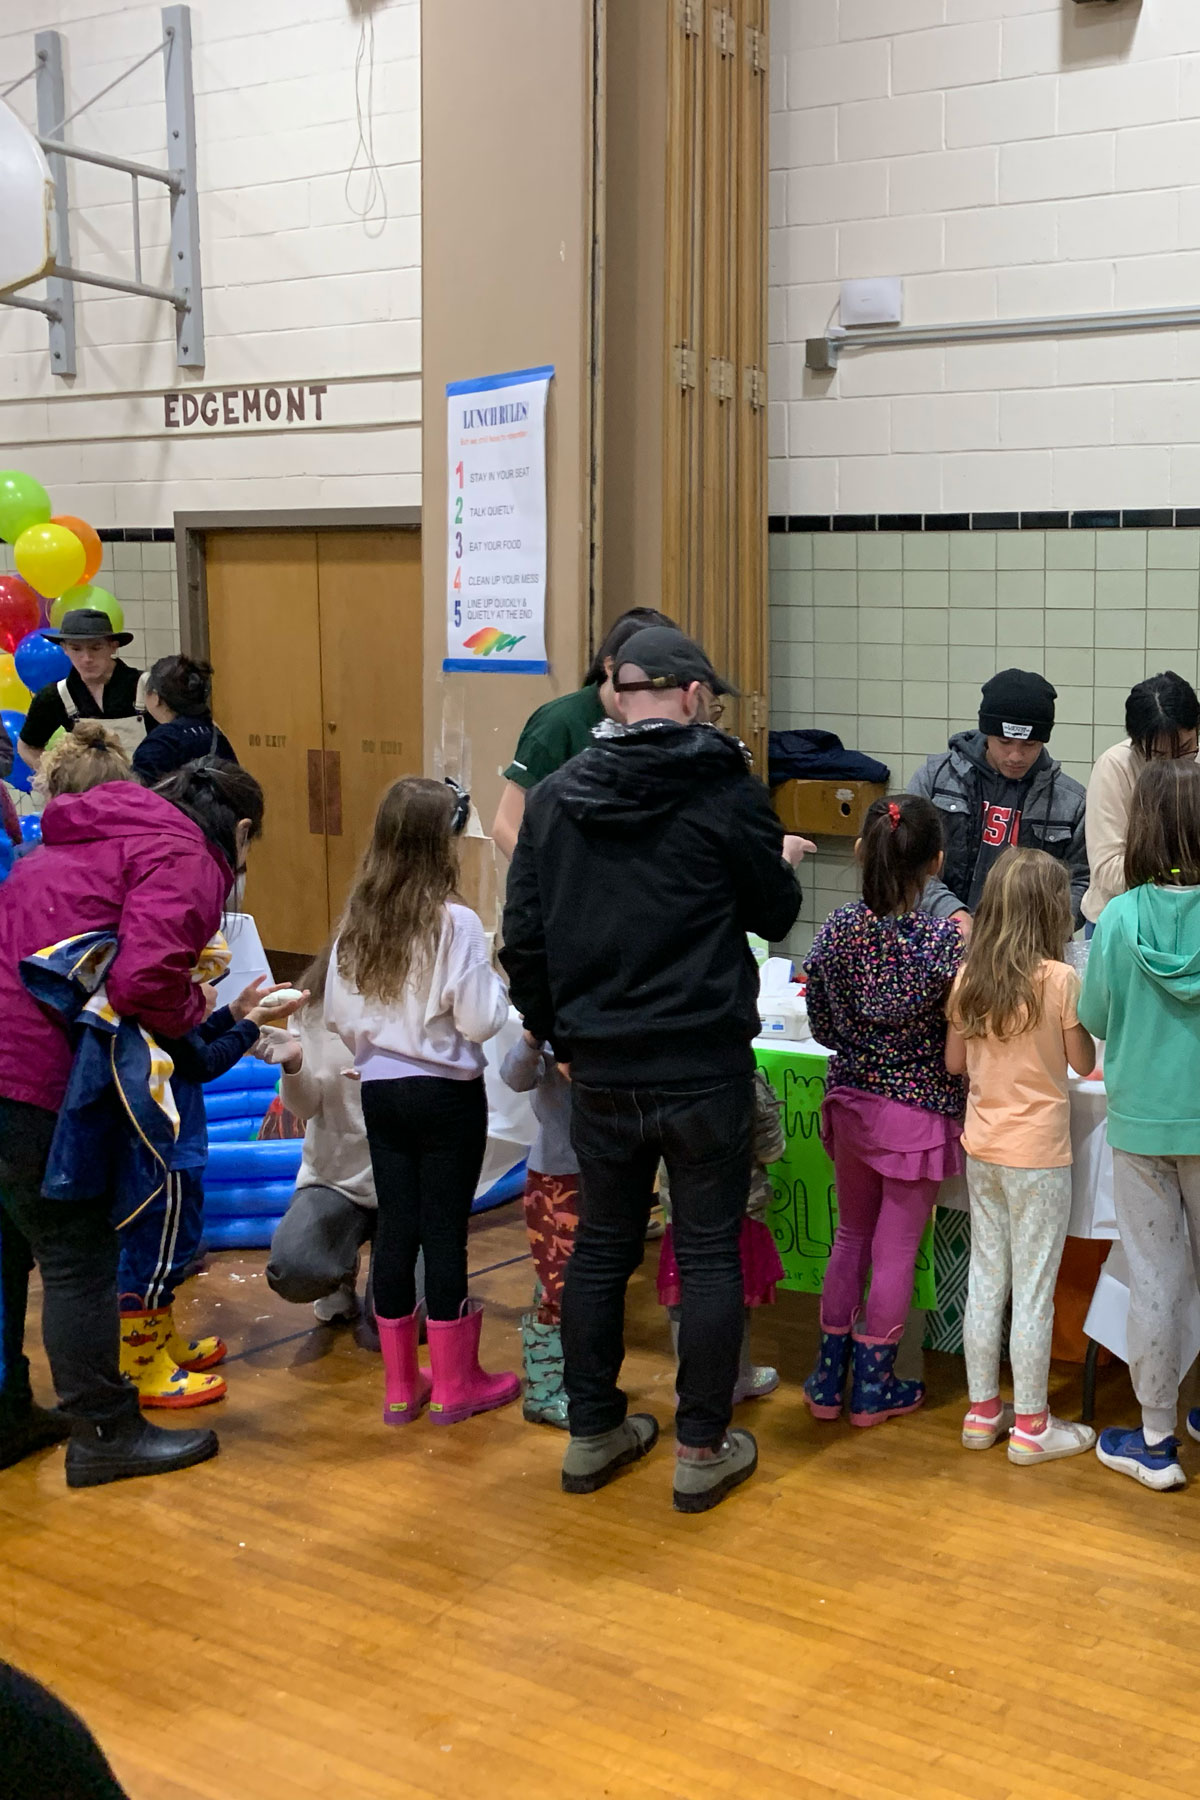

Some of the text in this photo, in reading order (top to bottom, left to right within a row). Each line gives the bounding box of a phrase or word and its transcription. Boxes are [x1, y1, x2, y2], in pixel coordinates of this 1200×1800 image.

[164, 385, 327, 428] EDGEMONT
[463, 407, 497, 429] LUNCH
[455, 461, 530, 489] 1 STAY IN YOUR SEAT
[455, 496, 515, 524] 2 TALK QUIETLY
[455, 531, 522, 559] 3 EAT YOUR FOOD
[453, 565, 539, 593] 4 CLEAN UP YOUR MESS
[454, 600, 462, 628] 5
[467, 599, 482, 609] LINE
[483, 599, 493, 608] UP
[494, 598, 521, 608] QUICKLY
[467, 609, 532, 620] QUIETLY AT THE END
[249, 734, 286, 748] NO EXIT
